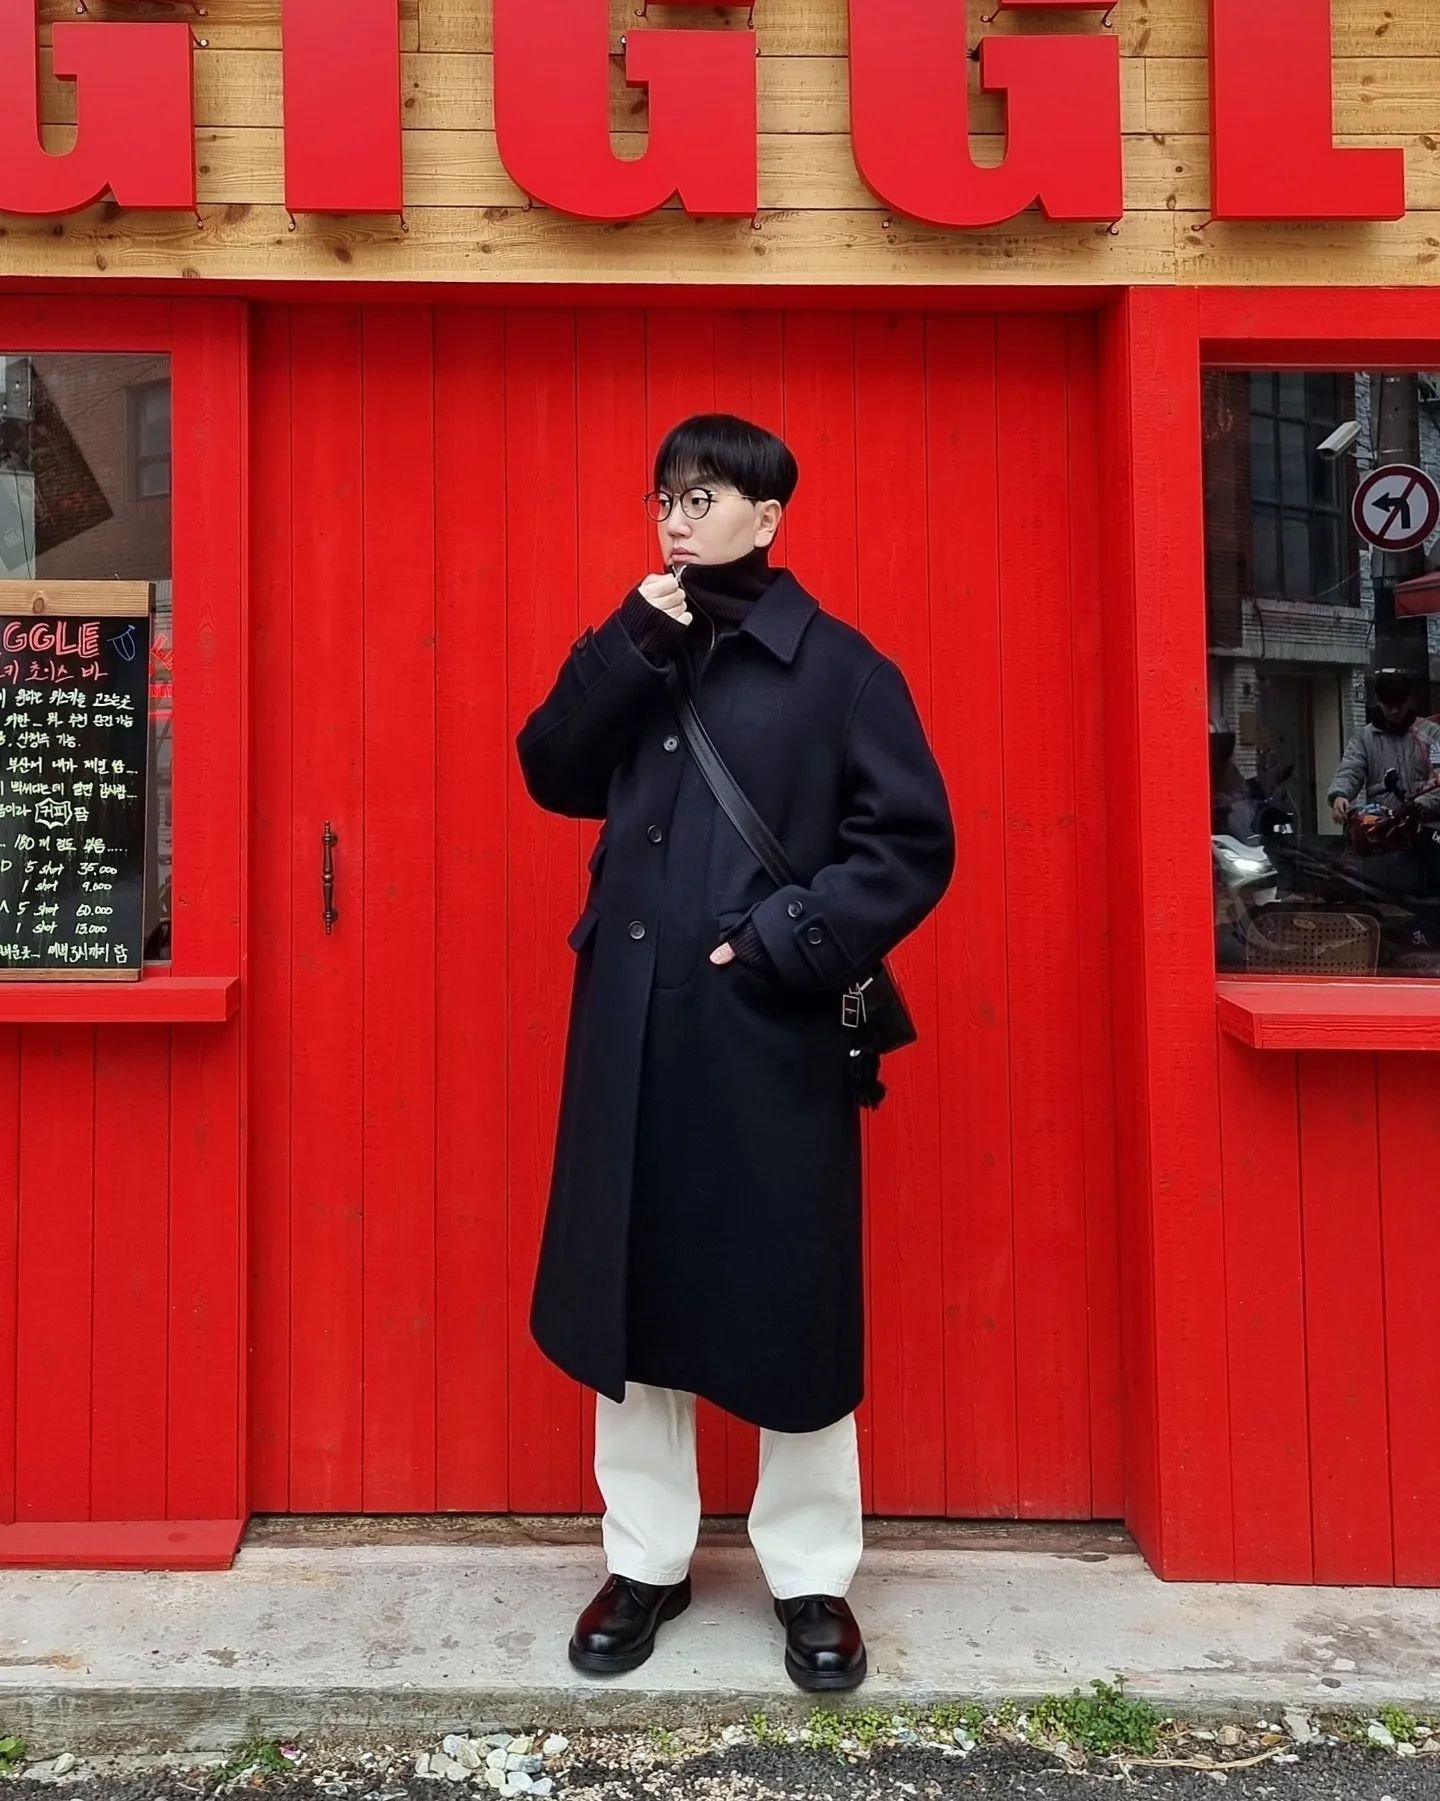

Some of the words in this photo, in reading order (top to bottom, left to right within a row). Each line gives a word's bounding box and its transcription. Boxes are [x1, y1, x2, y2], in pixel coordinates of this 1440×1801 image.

[0, 621, 99, 658] GGLE
[26, 661, 73, 682] 초이스
[81, 662, 107, 680] 바
[52, 758, 78, 772] 내가
[25, 860, 37, 873] 5
[39, 861, 64, 875] shot
[35, 879, 58, 891] shot
[17, 902, 30, 915] 5
